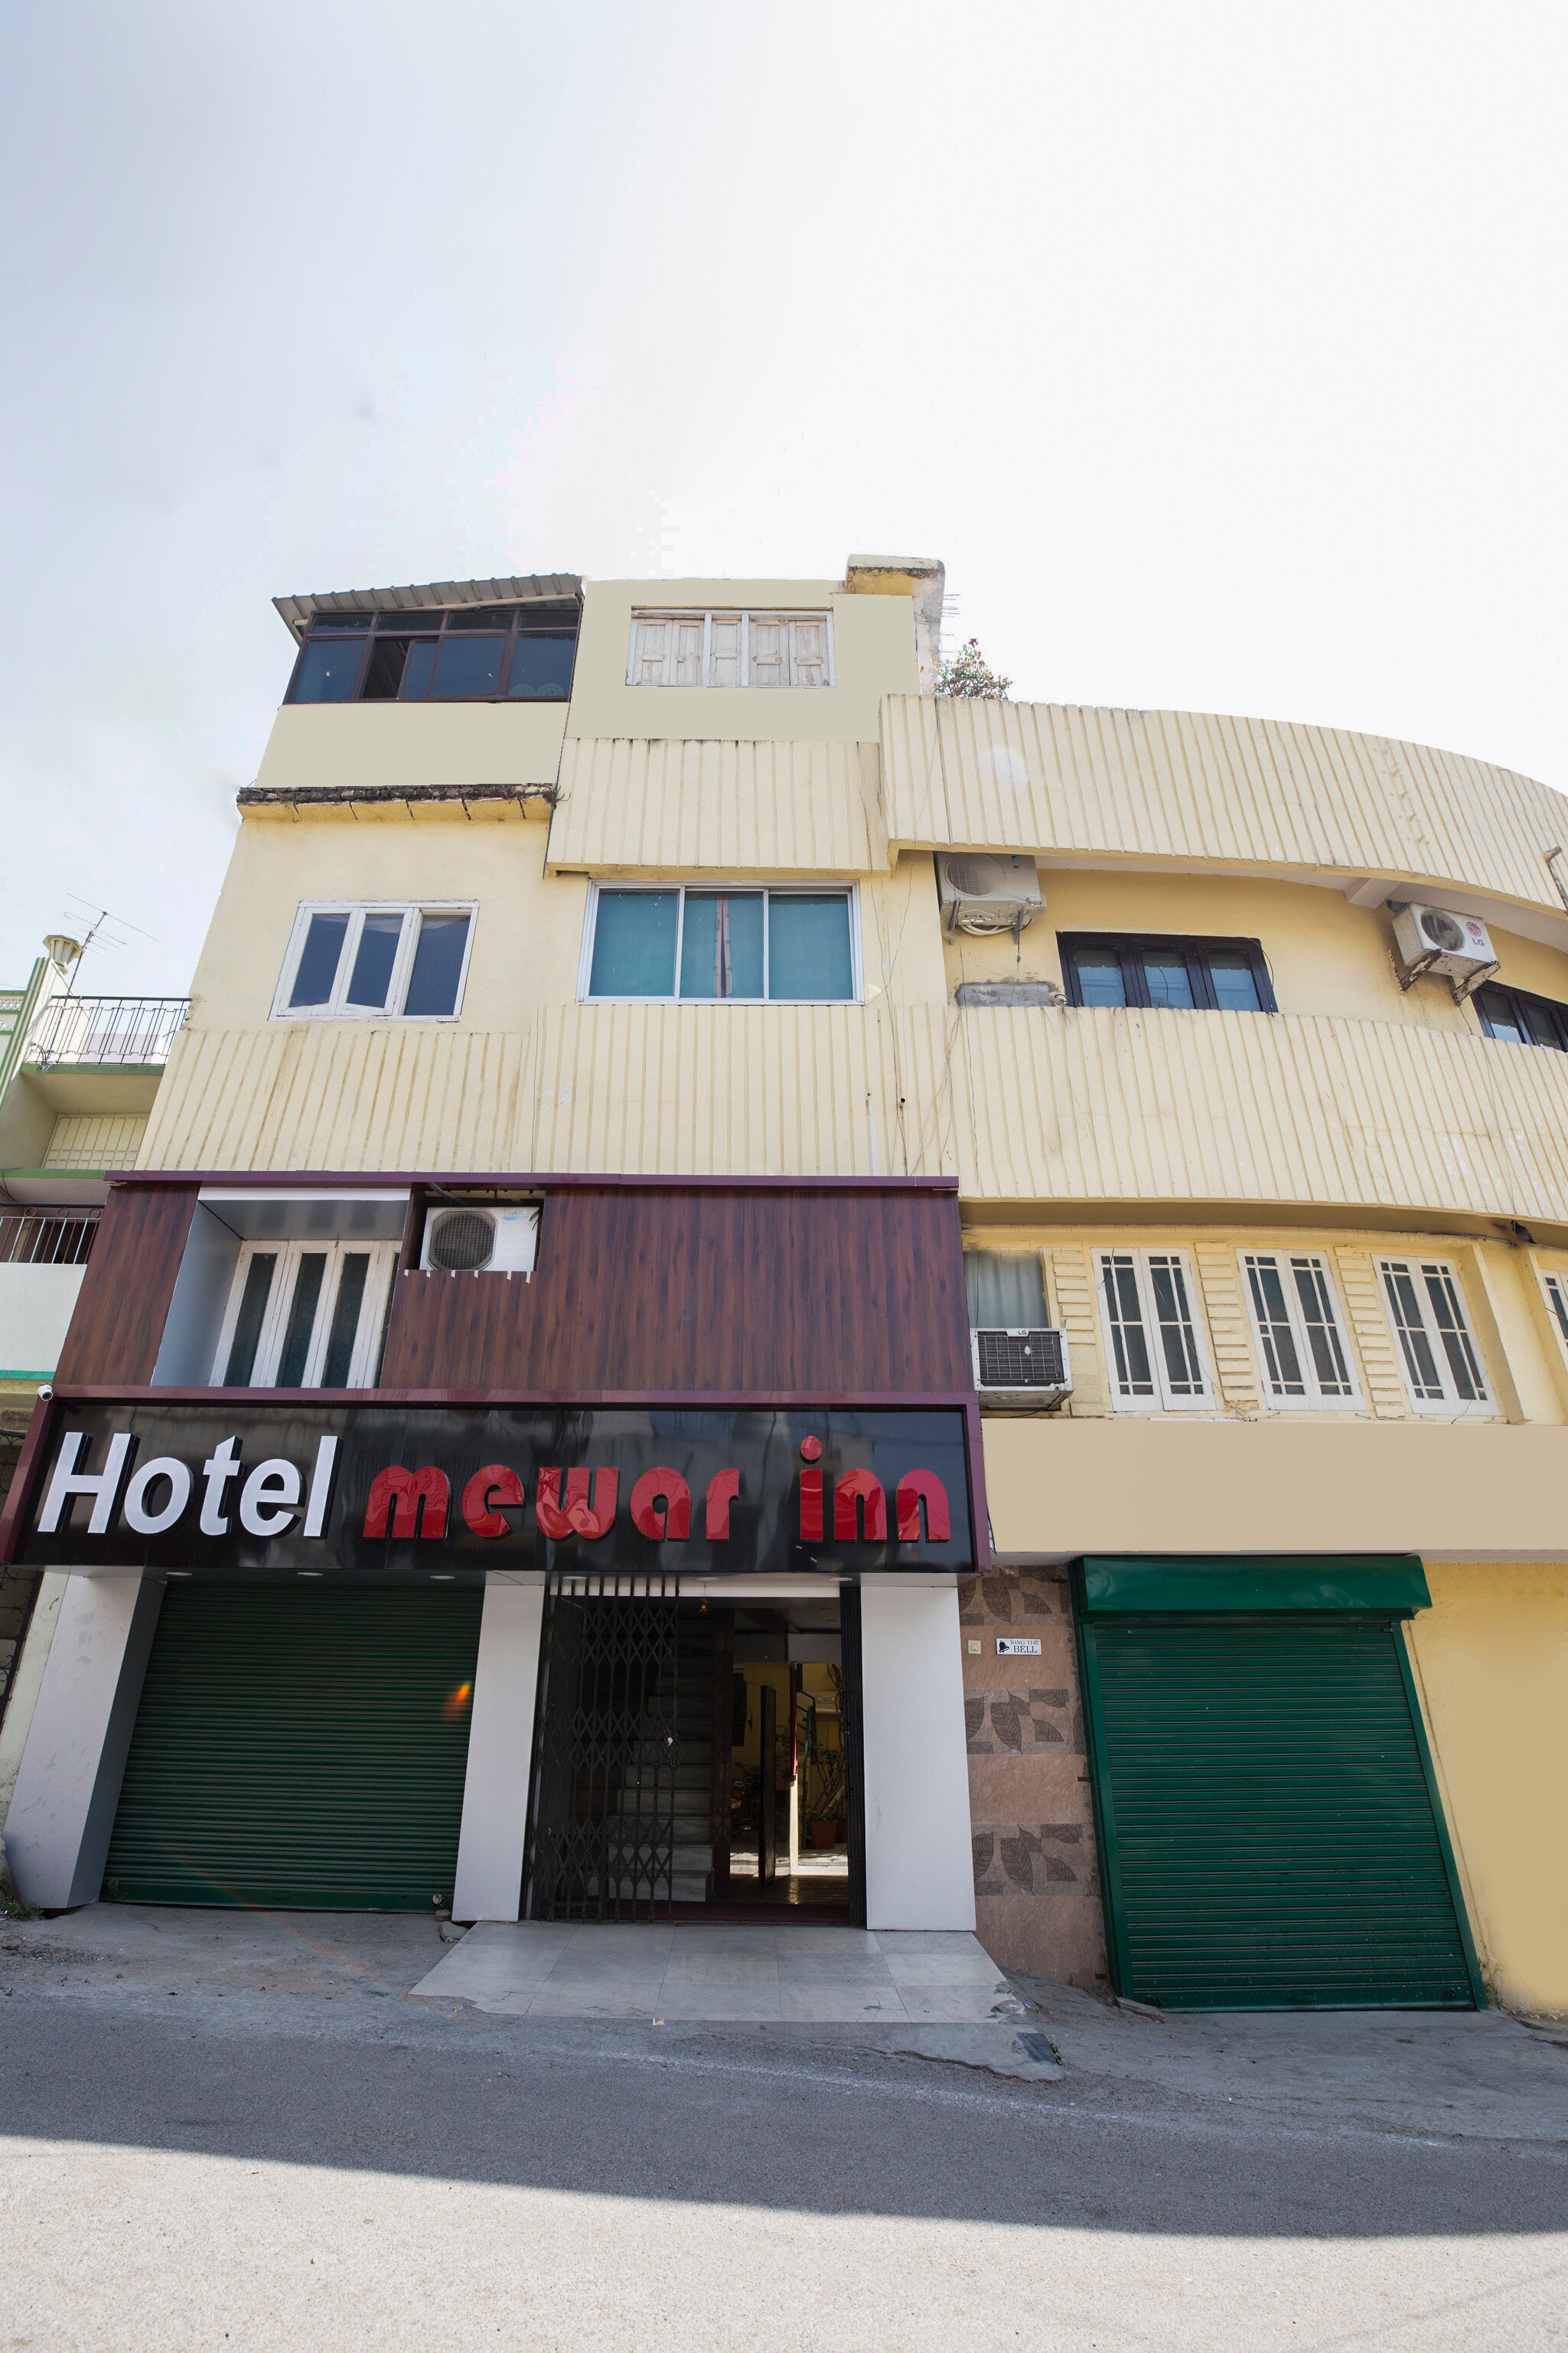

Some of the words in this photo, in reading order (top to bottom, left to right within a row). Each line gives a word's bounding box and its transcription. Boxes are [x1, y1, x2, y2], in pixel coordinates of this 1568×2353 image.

[1472, 938, 1485, 946] LG
[37, 1431, 341, 1537] Hotel
[363, 1464, 739, 1541] mewar
[800, 1435, 950, 1542] inn
